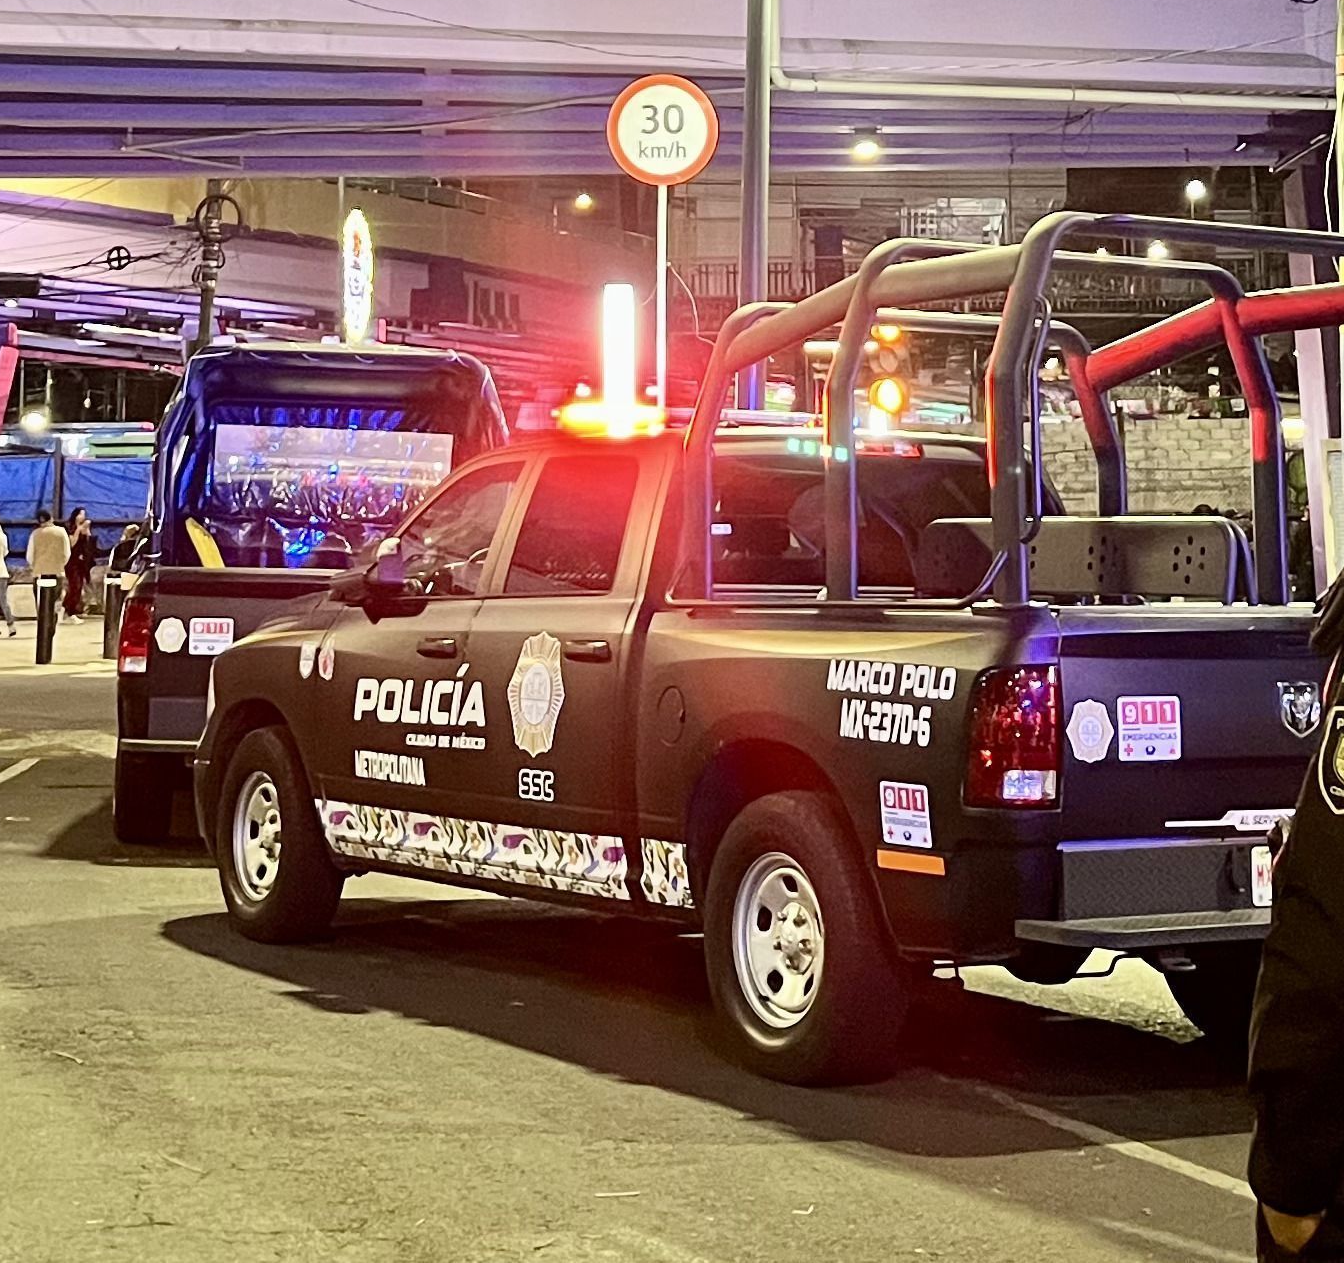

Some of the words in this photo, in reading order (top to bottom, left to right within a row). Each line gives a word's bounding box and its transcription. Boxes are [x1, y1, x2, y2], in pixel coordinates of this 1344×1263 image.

[641, 104, 684, 134] 30
[638, 141, 687, 158] km/h
[354, 662, 486, 727] POLICÍA
[826, 658, 896, 695] MARCO
[899, 664, 957, 700] POLO
[839, 698, 932, 747] MX-2370-6
[1123, 703, 1175, 723] 911
[354, 749, 426, 786] METROPOLITANA
[519, 768, 555, 802] SSC
[884, 787, 925, 811] 911
